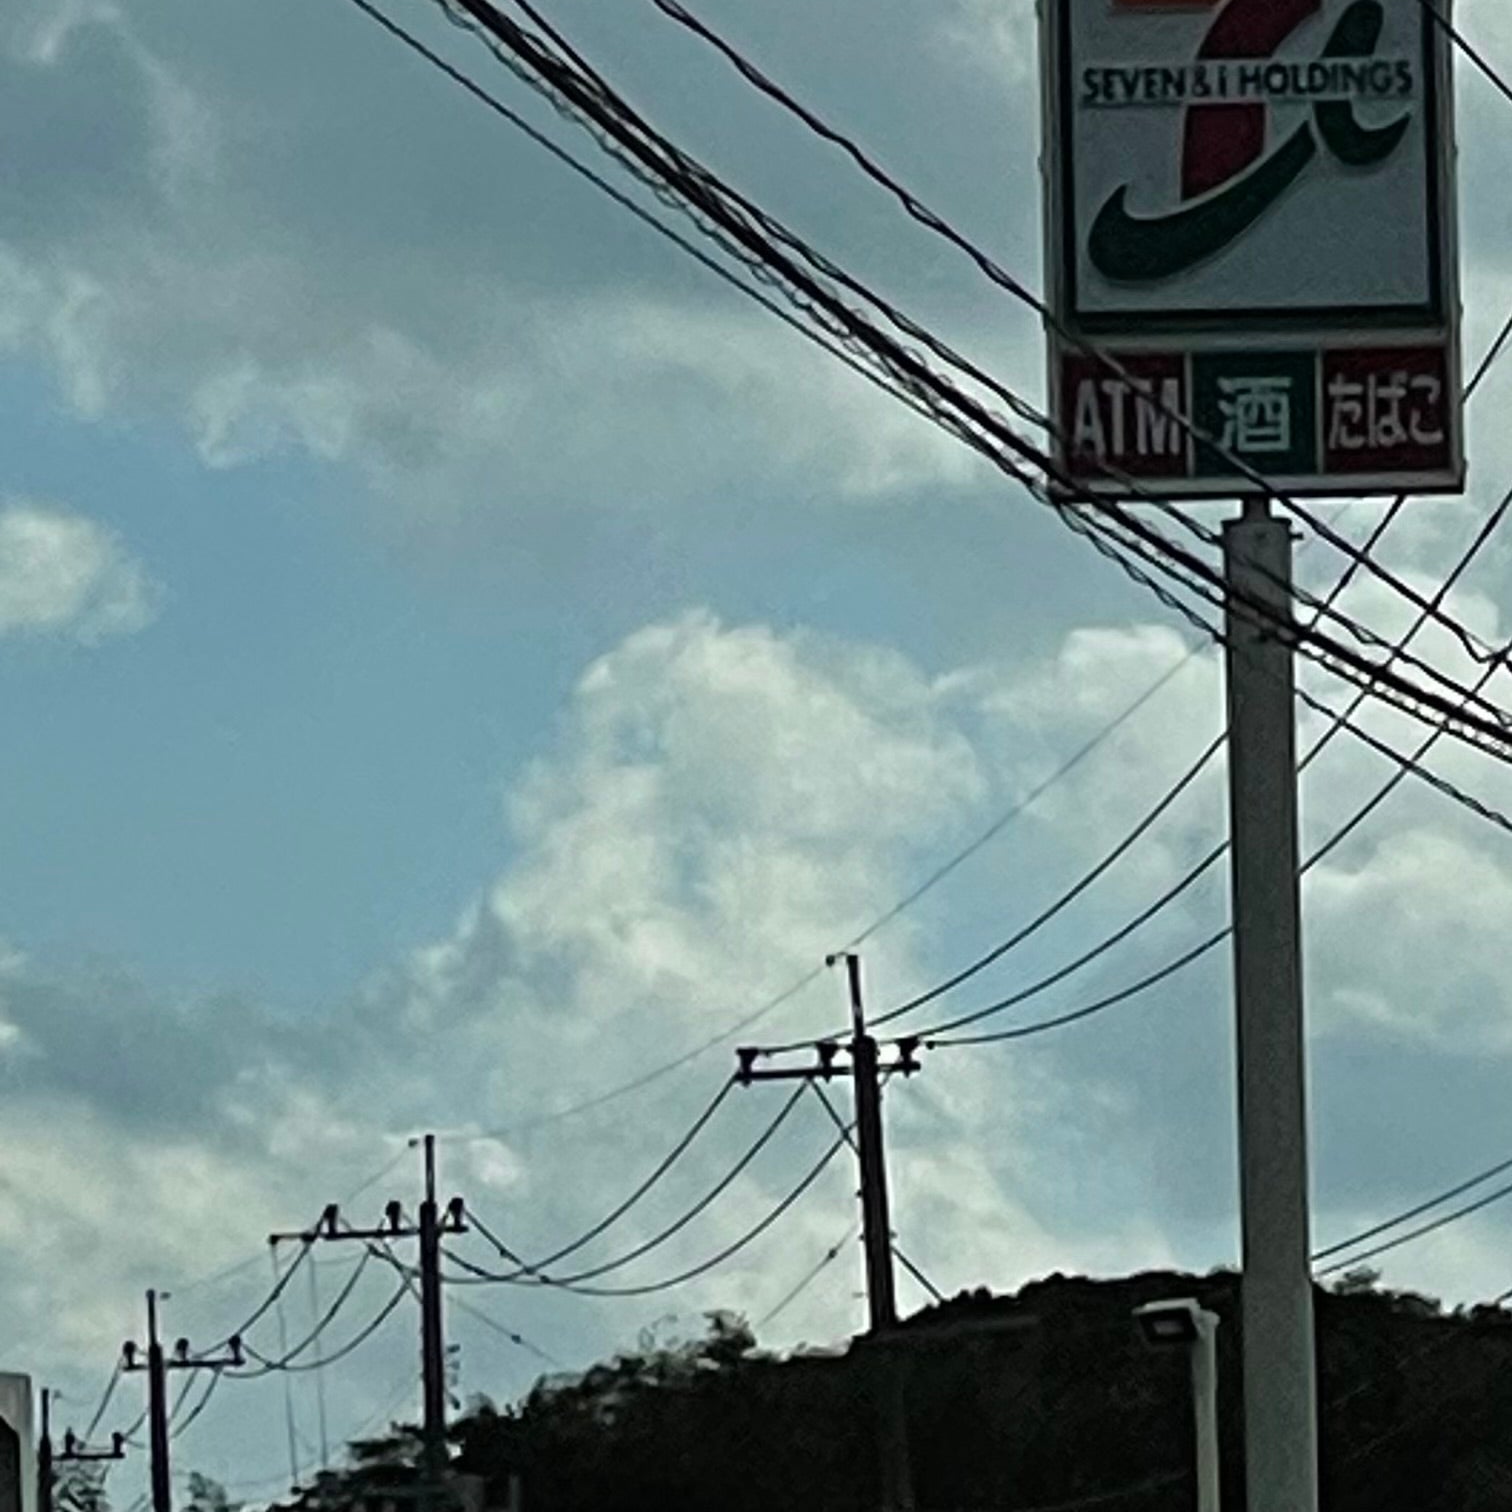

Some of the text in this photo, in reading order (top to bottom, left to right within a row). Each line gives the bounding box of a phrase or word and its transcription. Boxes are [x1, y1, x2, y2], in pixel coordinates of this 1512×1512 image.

[1239, 60, 1413, 95] HOLDINGS
[1074, 377, 1182, 456] ATM
[1217, 376, 1293, 453] 酒
[1328, 371, 1444, 451] たばこ
